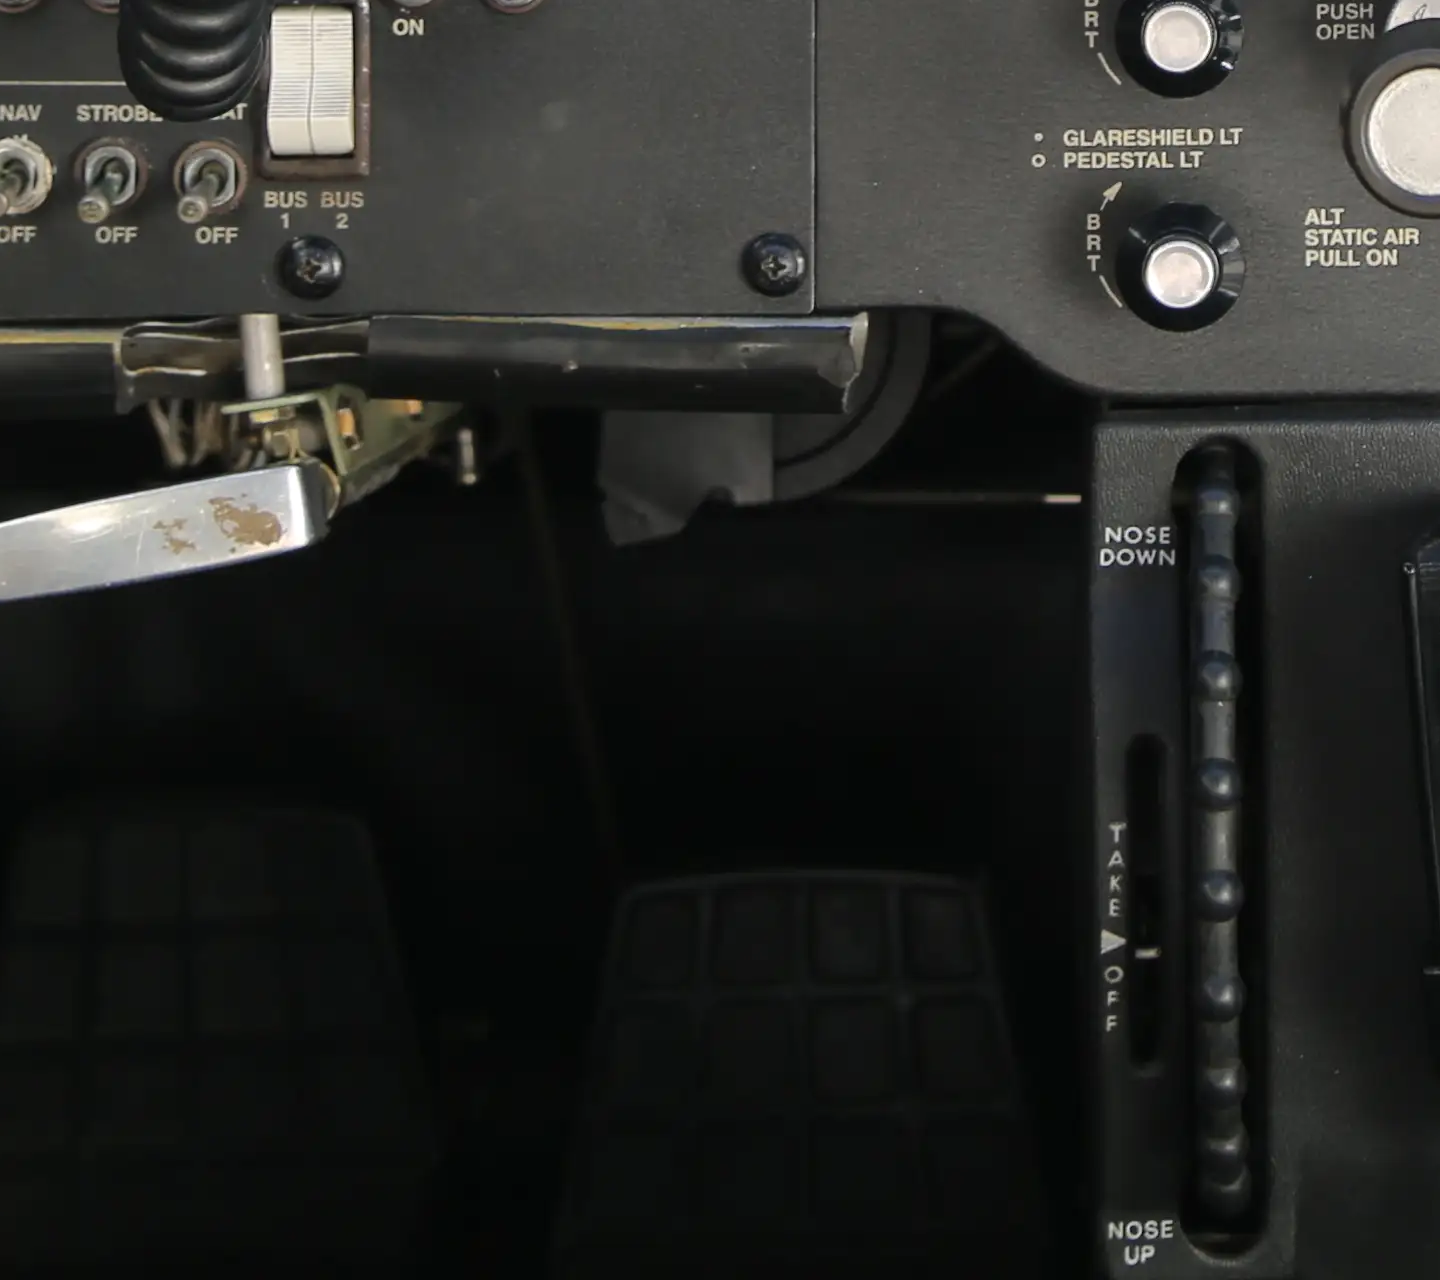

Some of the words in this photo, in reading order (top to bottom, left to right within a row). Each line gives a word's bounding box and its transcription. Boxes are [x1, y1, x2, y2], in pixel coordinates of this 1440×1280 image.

[1316, 2, 1374, 21] PUSH
[1315, 23, 1375, 41] OPEN
[1063, 128, 1213, 147] GLARESHIELD
[1219, 127, 1244, 145] LT
[1063, 151, 1175, 169] PEDESTAL
[1179, 150, 1204, 168] LT
[1304, 207, 1345, 226] ALT
[1304, 228, 1378, 247] STATIC
[1382, 227, 1420, 246] AIR
[1305, 249, 1361, 267] PULL
[1365, 248, 1398, 267] ON
[1104, 526, 1171, 545] NOSE
[1099, 547, 1175, 567] DOWN
[1108, 1219, 1174, 1240] NOSE
[1124, 1244, 1155, 1266] UP
